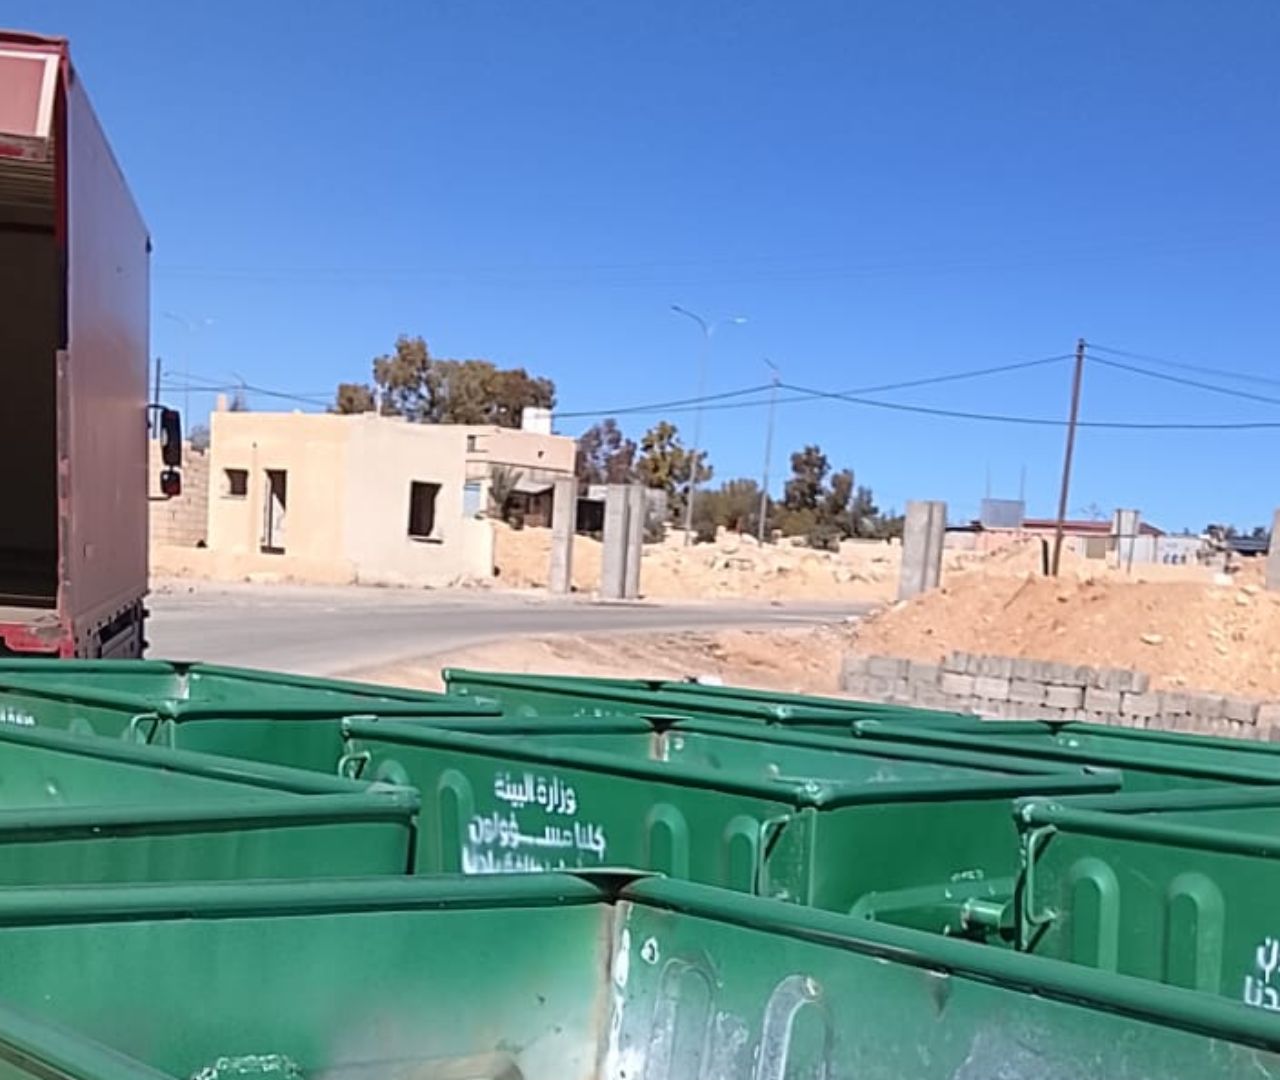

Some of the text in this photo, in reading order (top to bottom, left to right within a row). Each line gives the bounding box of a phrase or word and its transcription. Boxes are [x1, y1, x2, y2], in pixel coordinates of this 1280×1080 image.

[494, 772, 577, 814] وزارة البيئة
[574, 821, 606, 855] كلنا
